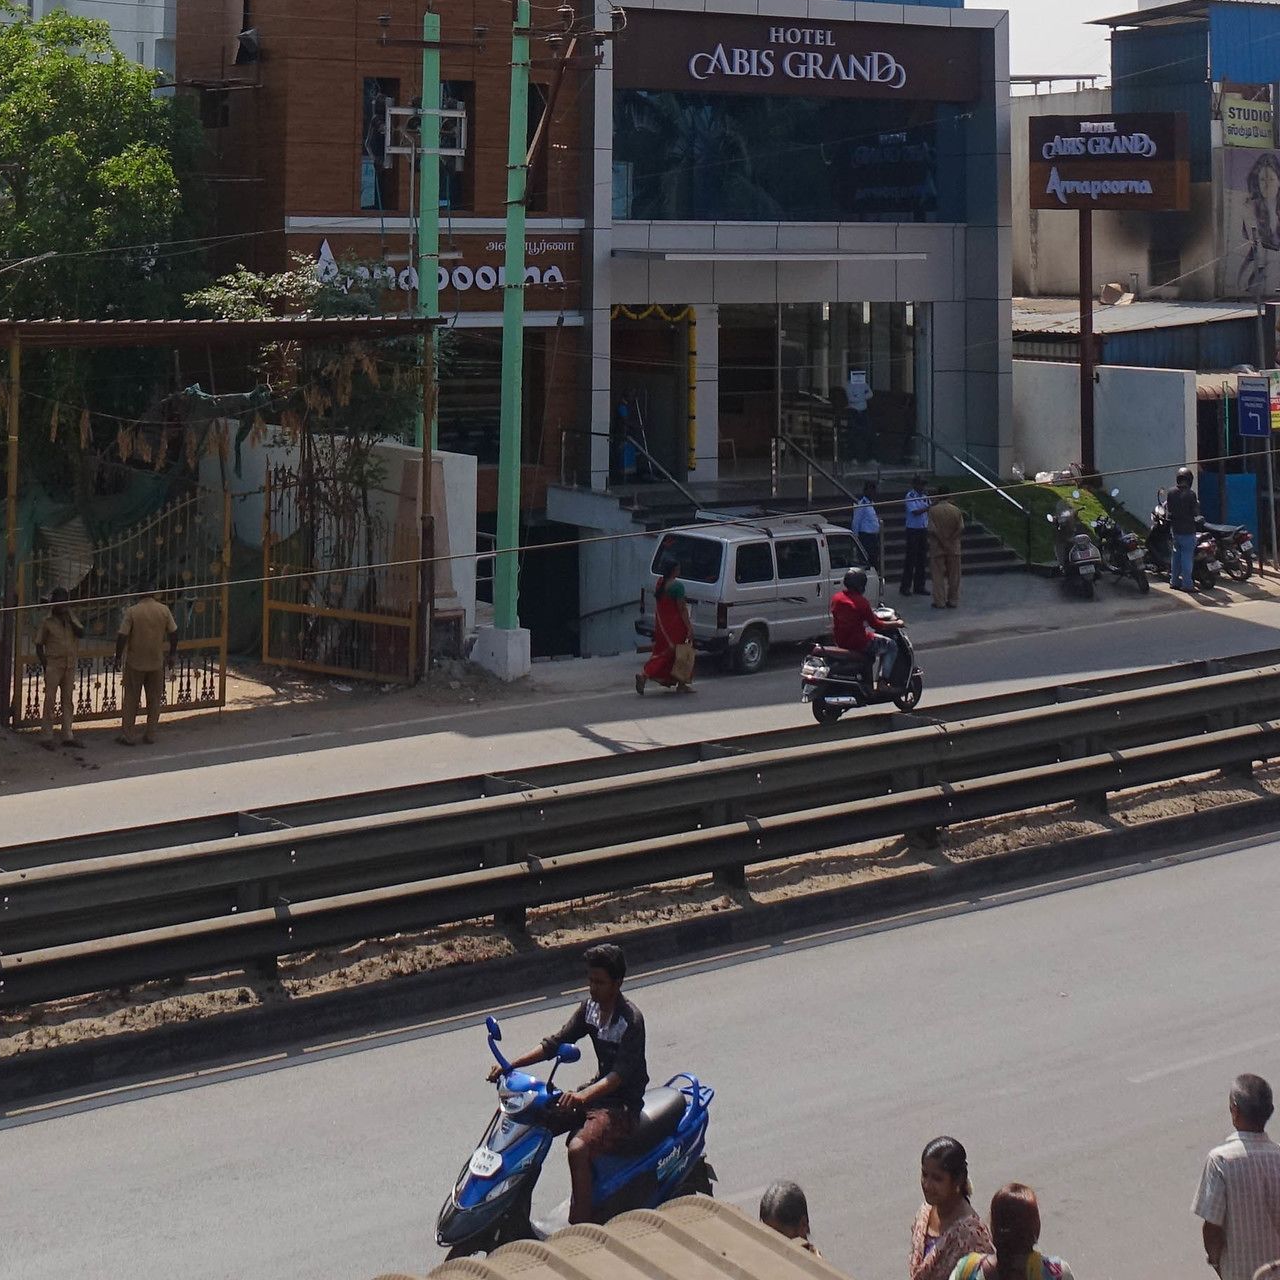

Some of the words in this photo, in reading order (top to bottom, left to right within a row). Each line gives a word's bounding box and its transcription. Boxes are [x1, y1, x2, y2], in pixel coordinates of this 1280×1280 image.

[770, 26, 836, 46] HOTEL
[688, 42, 775, 80] ABIS
[782, 50, 907, 89] GRAND
[1228, 106, 1271, 123] STUDIO
[1042, 135, 1087, 159] ABIS
[1087, 133, 1157, 158] GRAND
[1046, 166, 1153, 204] Annapoorna
